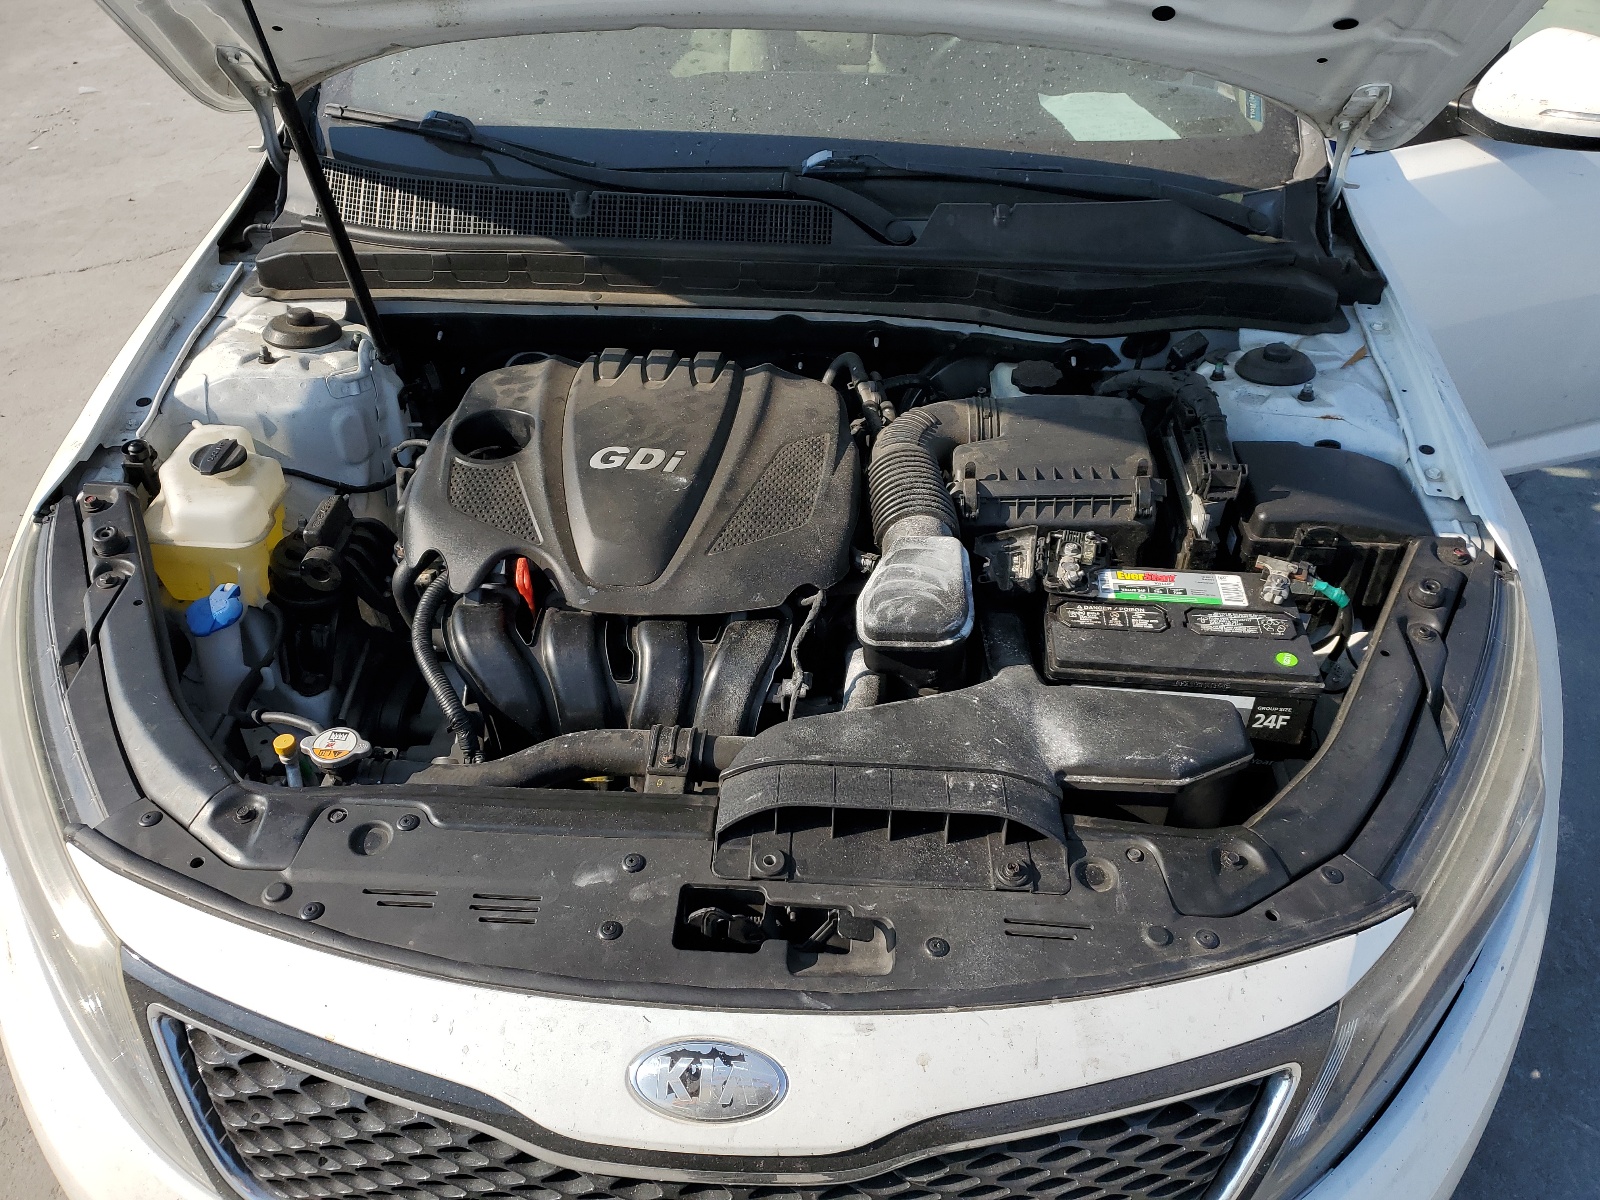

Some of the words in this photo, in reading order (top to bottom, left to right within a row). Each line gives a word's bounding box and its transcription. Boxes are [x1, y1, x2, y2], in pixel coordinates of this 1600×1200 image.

[589, 446, 687, 473] GDi
[1116, 571, 1176, 582] EverStart
[1251, 713, 1291, 730] 24F
[655, 1055, 759, 1106] KIA
